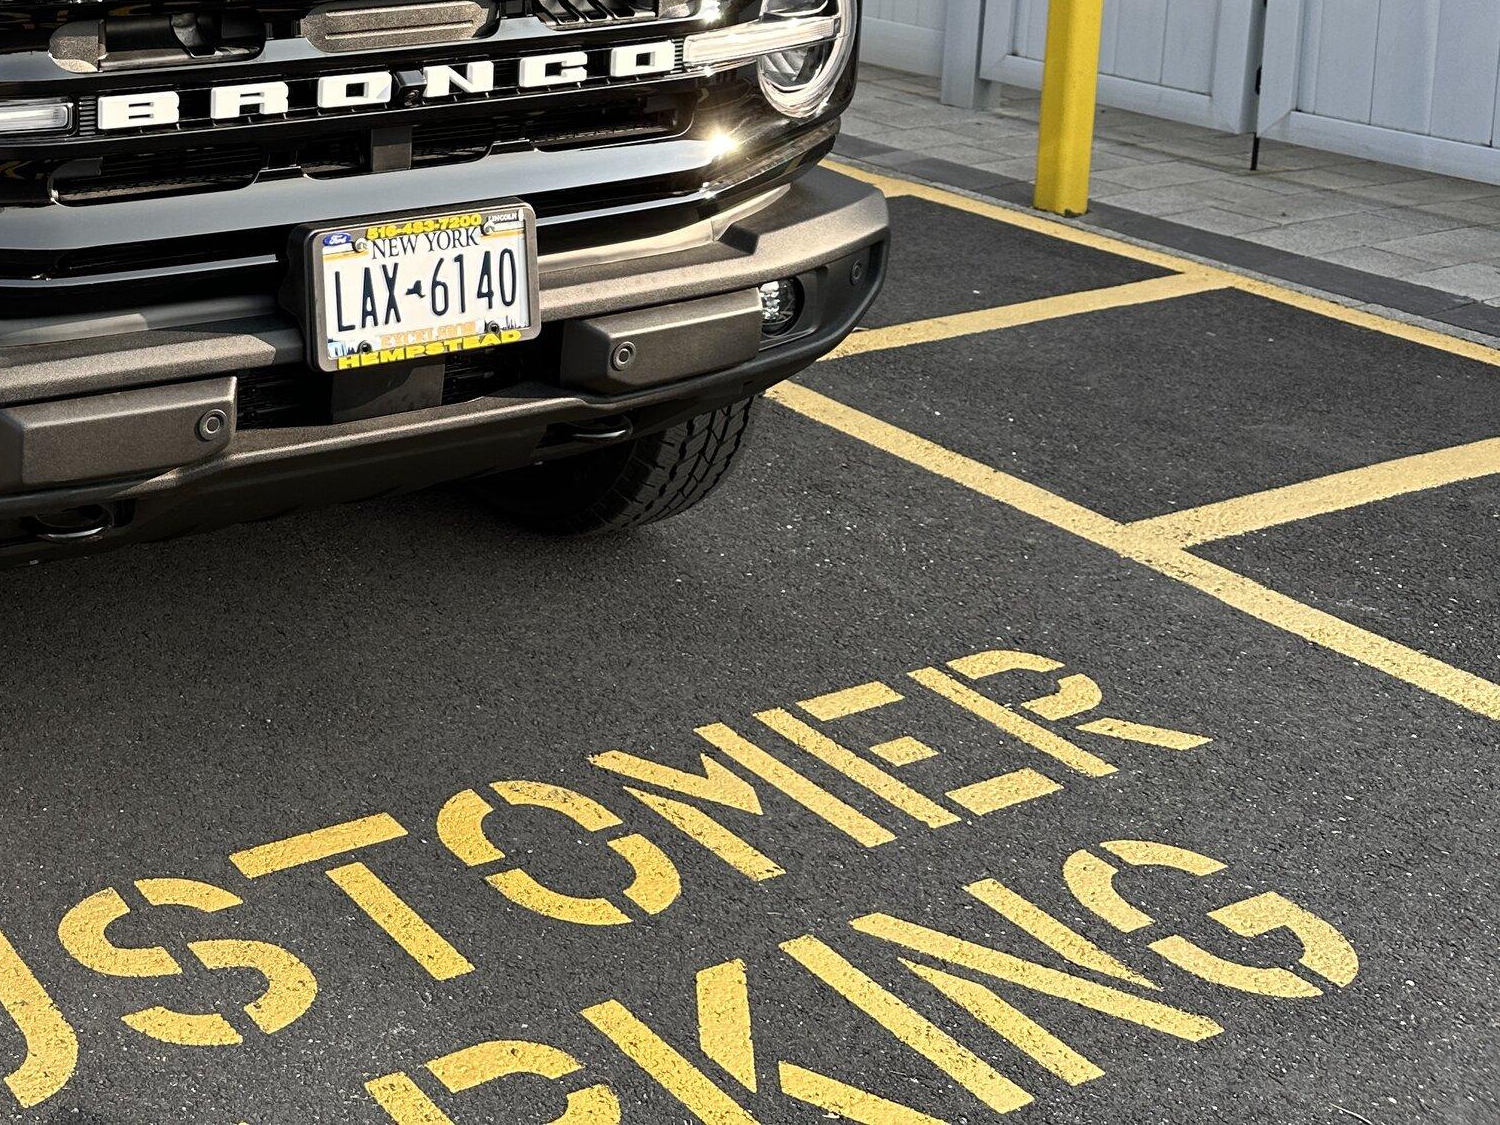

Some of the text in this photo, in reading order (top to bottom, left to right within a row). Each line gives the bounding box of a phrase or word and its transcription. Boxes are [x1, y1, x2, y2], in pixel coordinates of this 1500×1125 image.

[98, 39, 676, 131] BRONCO
[488, 212, 517, 222] LINCOLN
[372, 226, 480, 259] NEW YORK
[335, 248, 516, 332] LAX 6140
[338, 330, 522, 370] HEMPSTEAD
